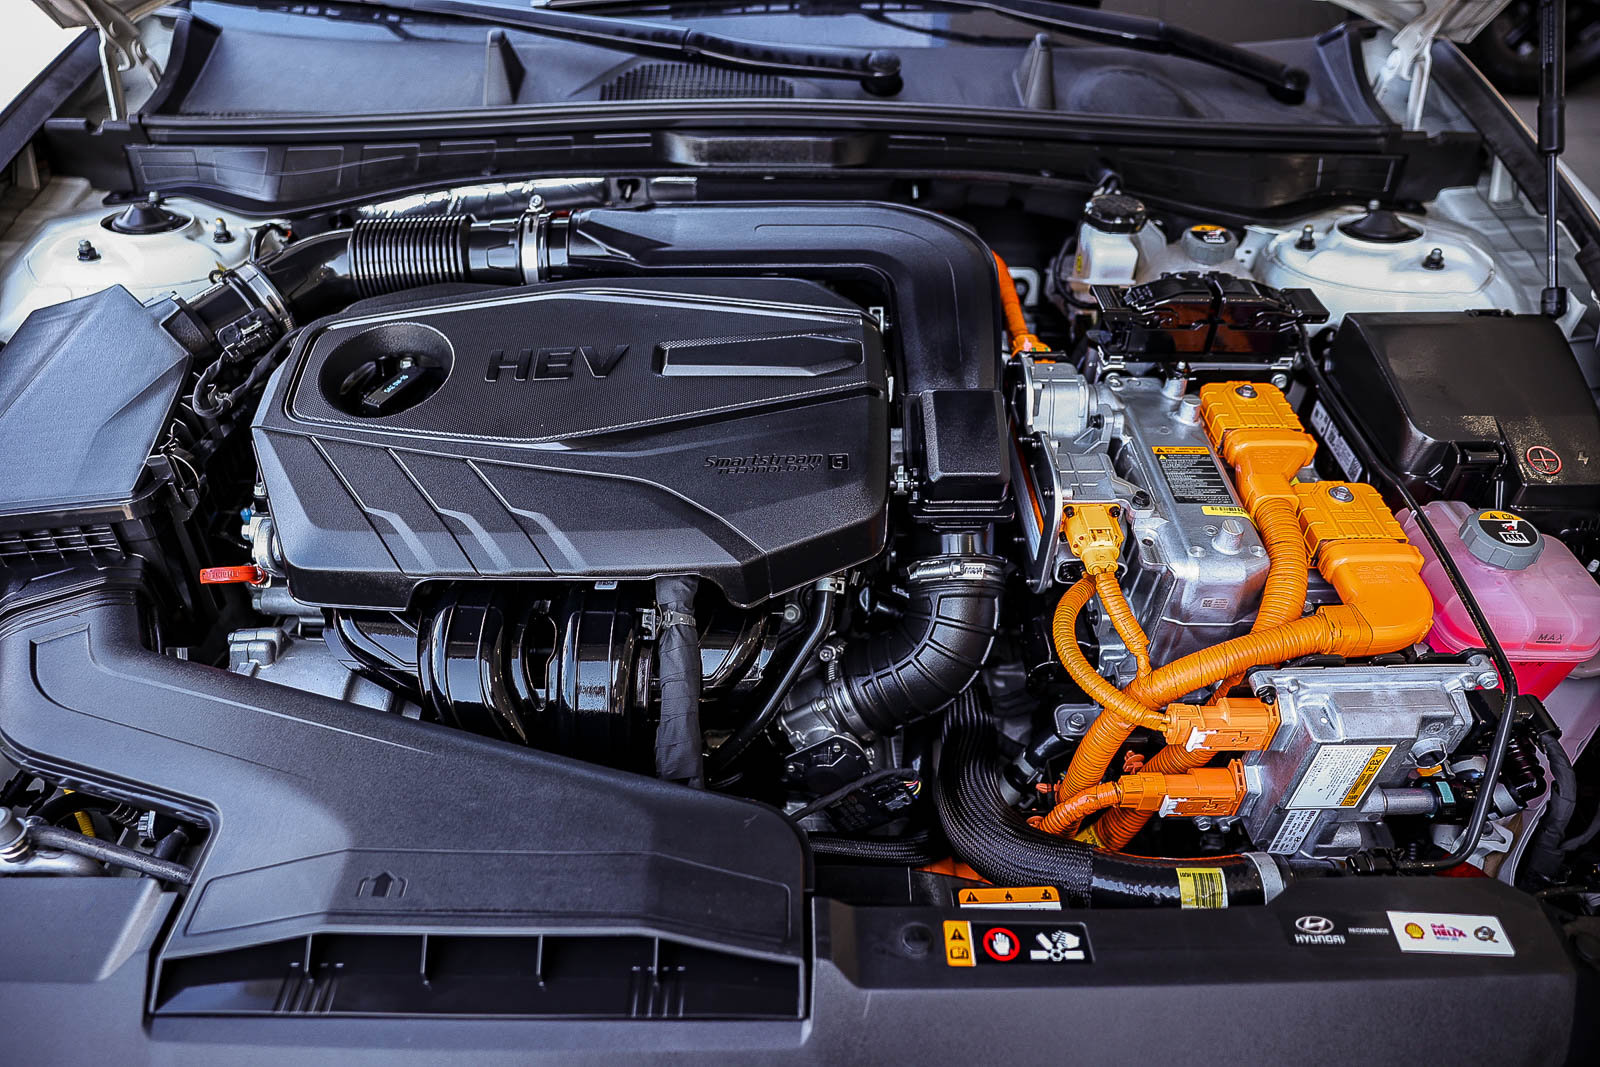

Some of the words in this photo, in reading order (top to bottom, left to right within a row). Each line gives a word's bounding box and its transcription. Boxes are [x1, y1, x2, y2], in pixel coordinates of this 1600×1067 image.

[485, 344, 630, 382] HEV
[704, 453, 823, 468] Smartstream
[718, 463, 820, 474] TECHNOLOGY
[1537, 633, 1565, 641] MAX
[1432, 927, 1467, 938] HELIX
[1294, 933, 1346, 945] HYUNDAI
